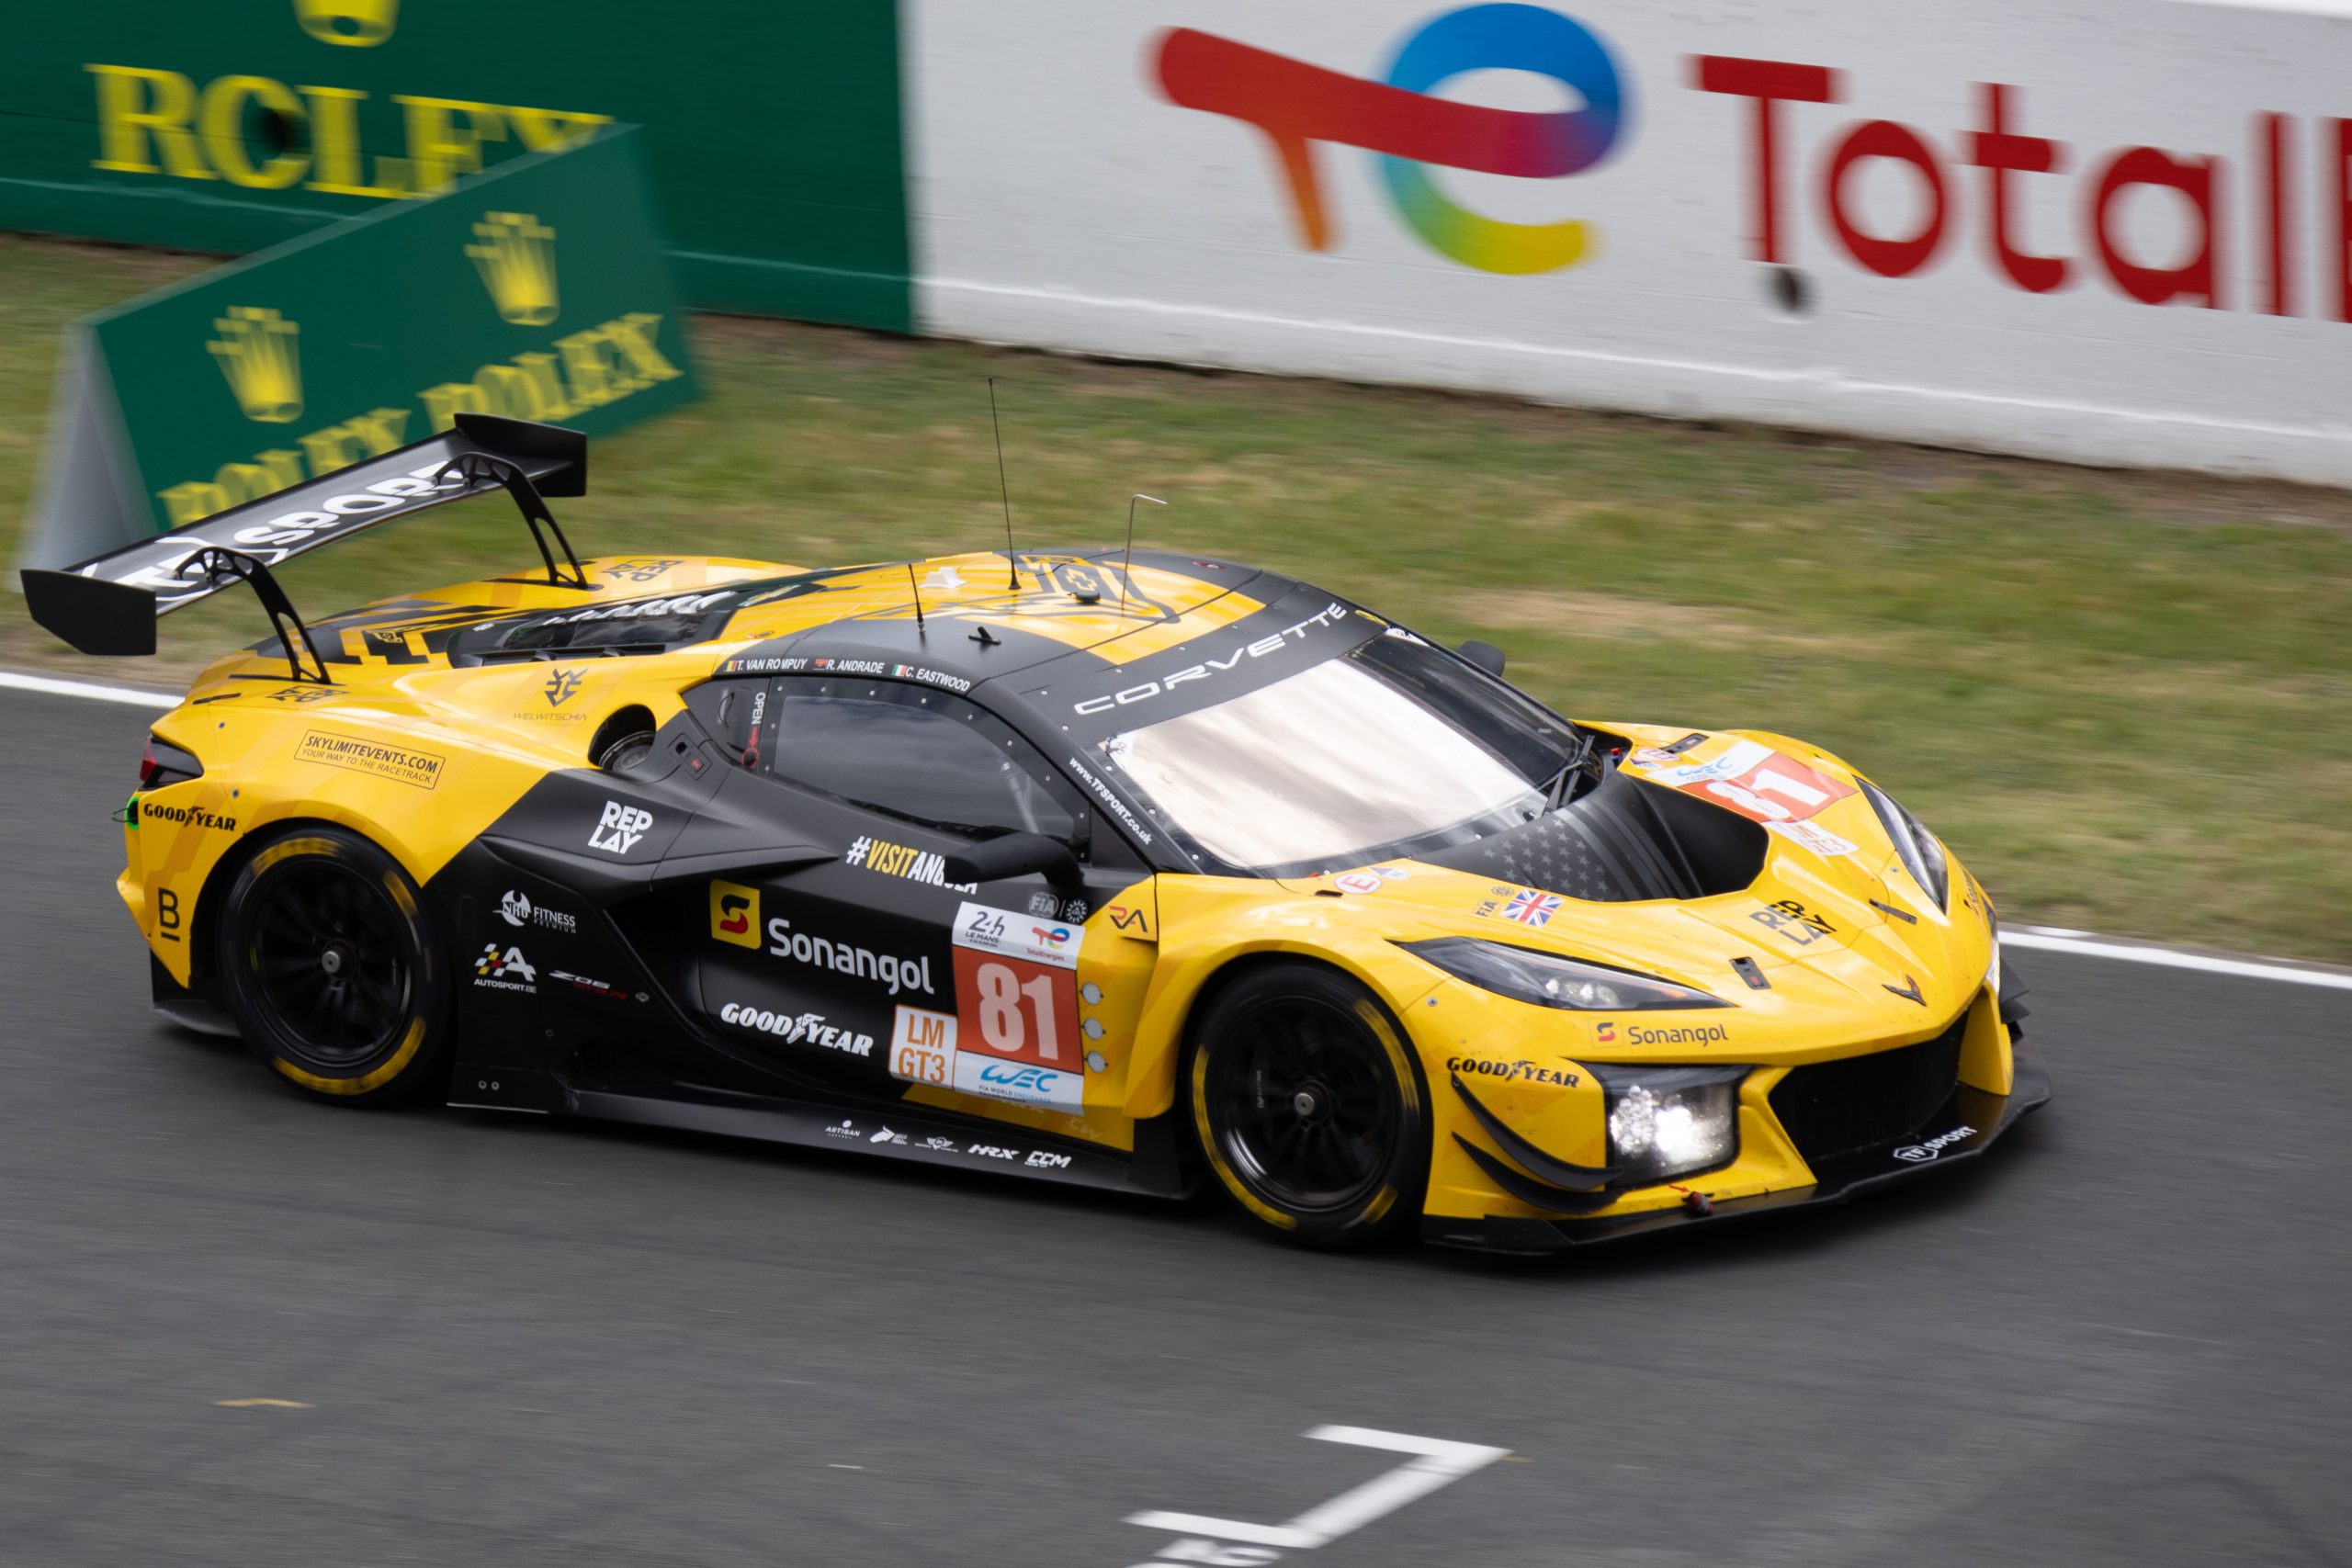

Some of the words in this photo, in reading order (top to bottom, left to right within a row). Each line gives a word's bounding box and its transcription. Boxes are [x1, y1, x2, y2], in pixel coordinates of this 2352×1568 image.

[1681, 51, 2352, 322] Total
[736, 660, 743, 671] T.
[746, 660, 765, 671] VAN
[767, 658, 808, 671] ROMPUY
[827, 660, 835, 671] R.
[837, 660, 885, 673] ANDRADE
[1074, 602, 1347, 716] CORVETTE
[906, 666, 914, 679] C.
[916, 668, 970, 692] EASTWOOD
[751, 692, 765, 726] OPEN
[302, 748, 324, 759] YOUR
[326, 750, 345, 761] WAY
[346, 755, 357, 765] TO
[360, 759, 375, 769] THE
[378, 763, 432, 784] RACETRACK
[306, 736, 438, 773] SKYLIMITEVENTS.COM
[1069, 757, 1152, 845] www.TFSPORT.co.uk
[143, 802, 236, 831] GOODYEAR
[599, 800, 653, 833] REP
[588, 824, 642, 854] LAY
[534, 907, 576, 927] FITNESS
[534, 919, 577, 934] PREMIUM
[1748, 899, 1806, 931] REP
[977, 933, 1000, 944] MANS
[768, 918, 934, 995] Sonangol
[1026, 947, 1065, 962] TotalEnergies
[474, 978, 537, 994] AUTOSPORT.BE
[977, 962, 1058, 1061] 81
[720, 1003, 873, 1057] GOODYEAR
[907, 1013, 944, 1049] LM
[1628, 1022, 1729, 1048] Sonangol
[898, 1047, 945, 1085] GT3
[980, 1065, 1058, 1093] WEC
[1447, 1056, 1579, 1089] GOODYEAR
[825, 1126, 861, 1137] ARTISAN
[1924, 1126, 1977, 1149] SPORT
[967, 1145, 1020, 1160] HRX
